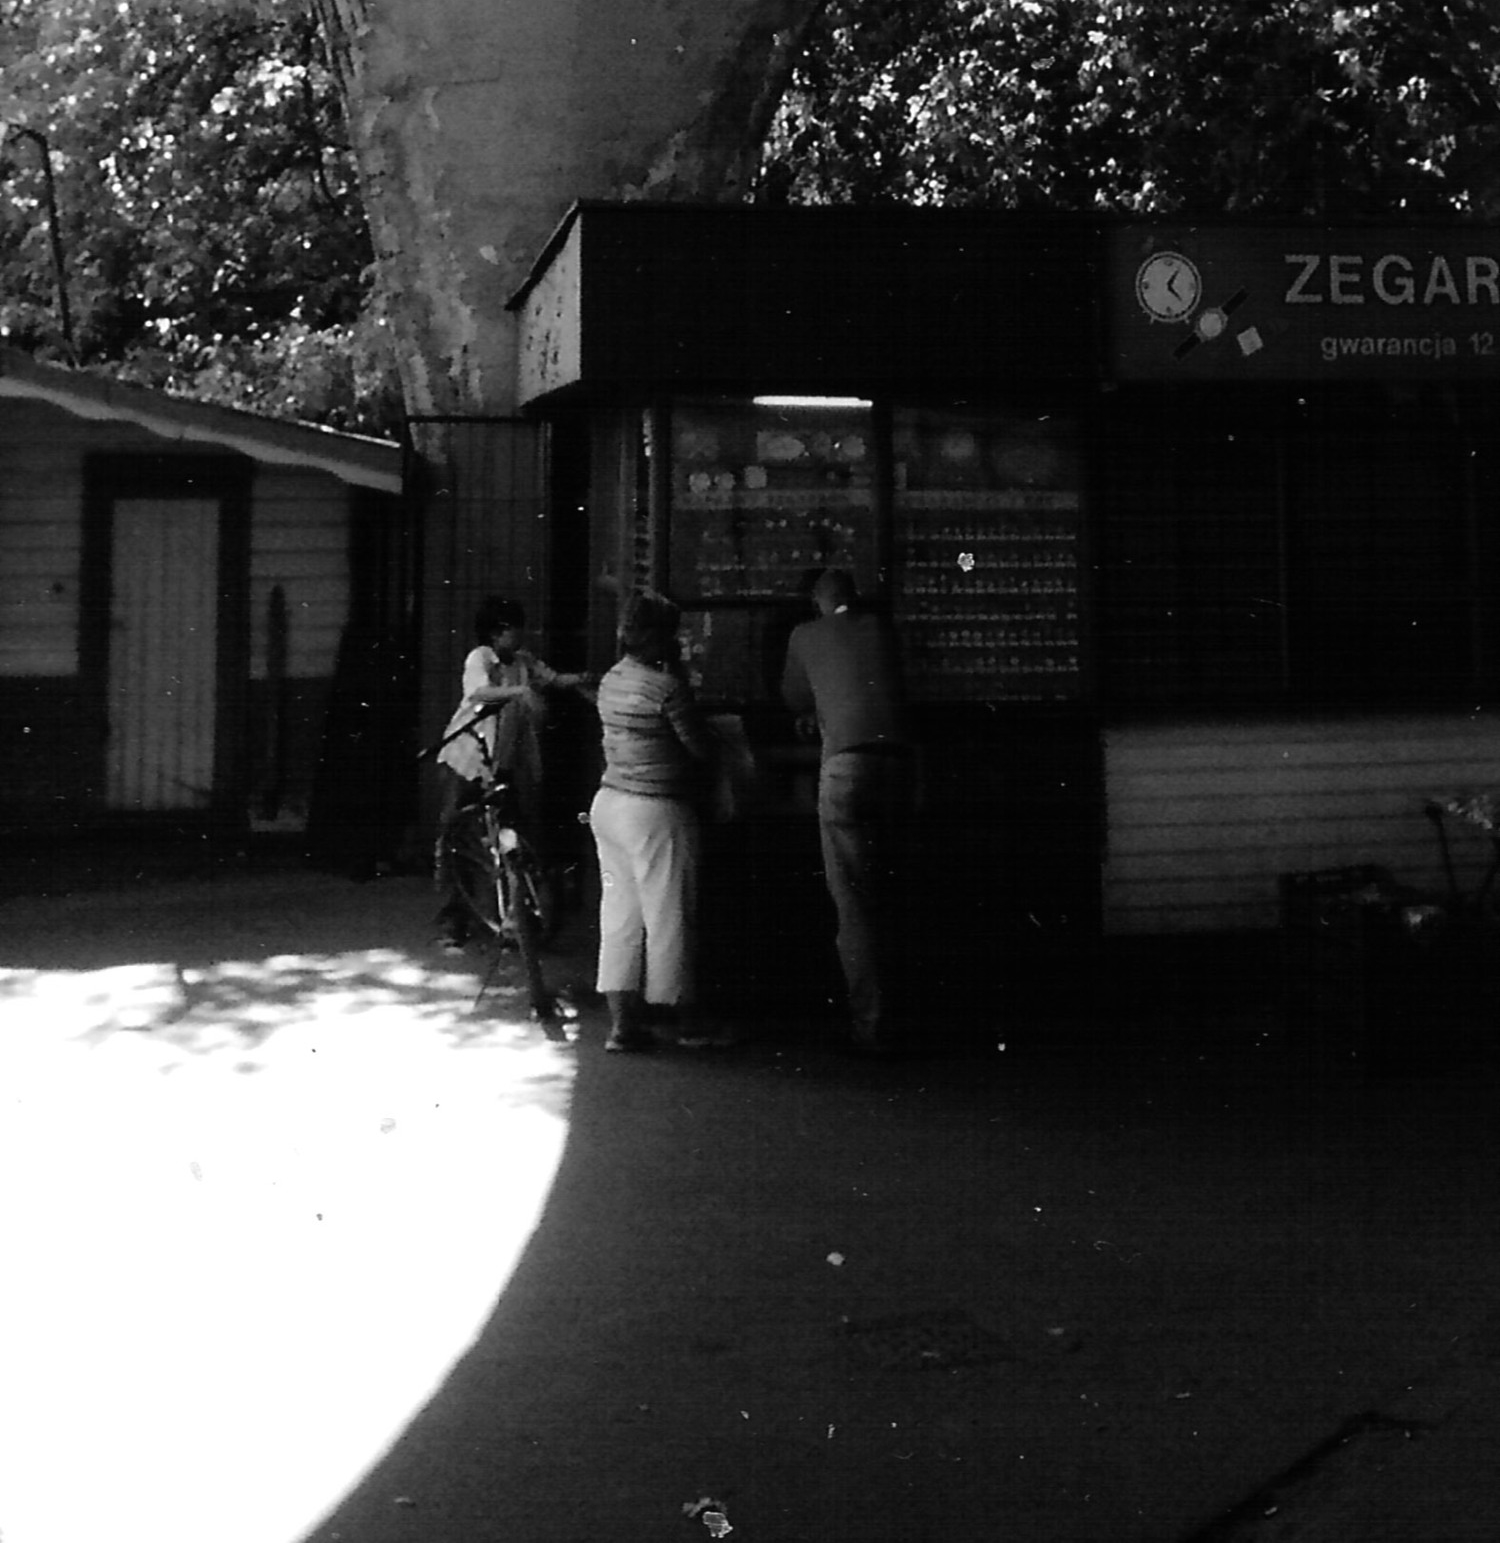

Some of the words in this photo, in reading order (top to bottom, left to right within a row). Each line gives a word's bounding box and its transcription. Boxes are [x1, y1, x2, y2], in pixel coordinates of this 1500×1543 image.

[1285, 254, 1500, 305] ZEGAR
[1320, 332, 1457, 361] gwarancja
[1469, 332, 1494, 355] 12
